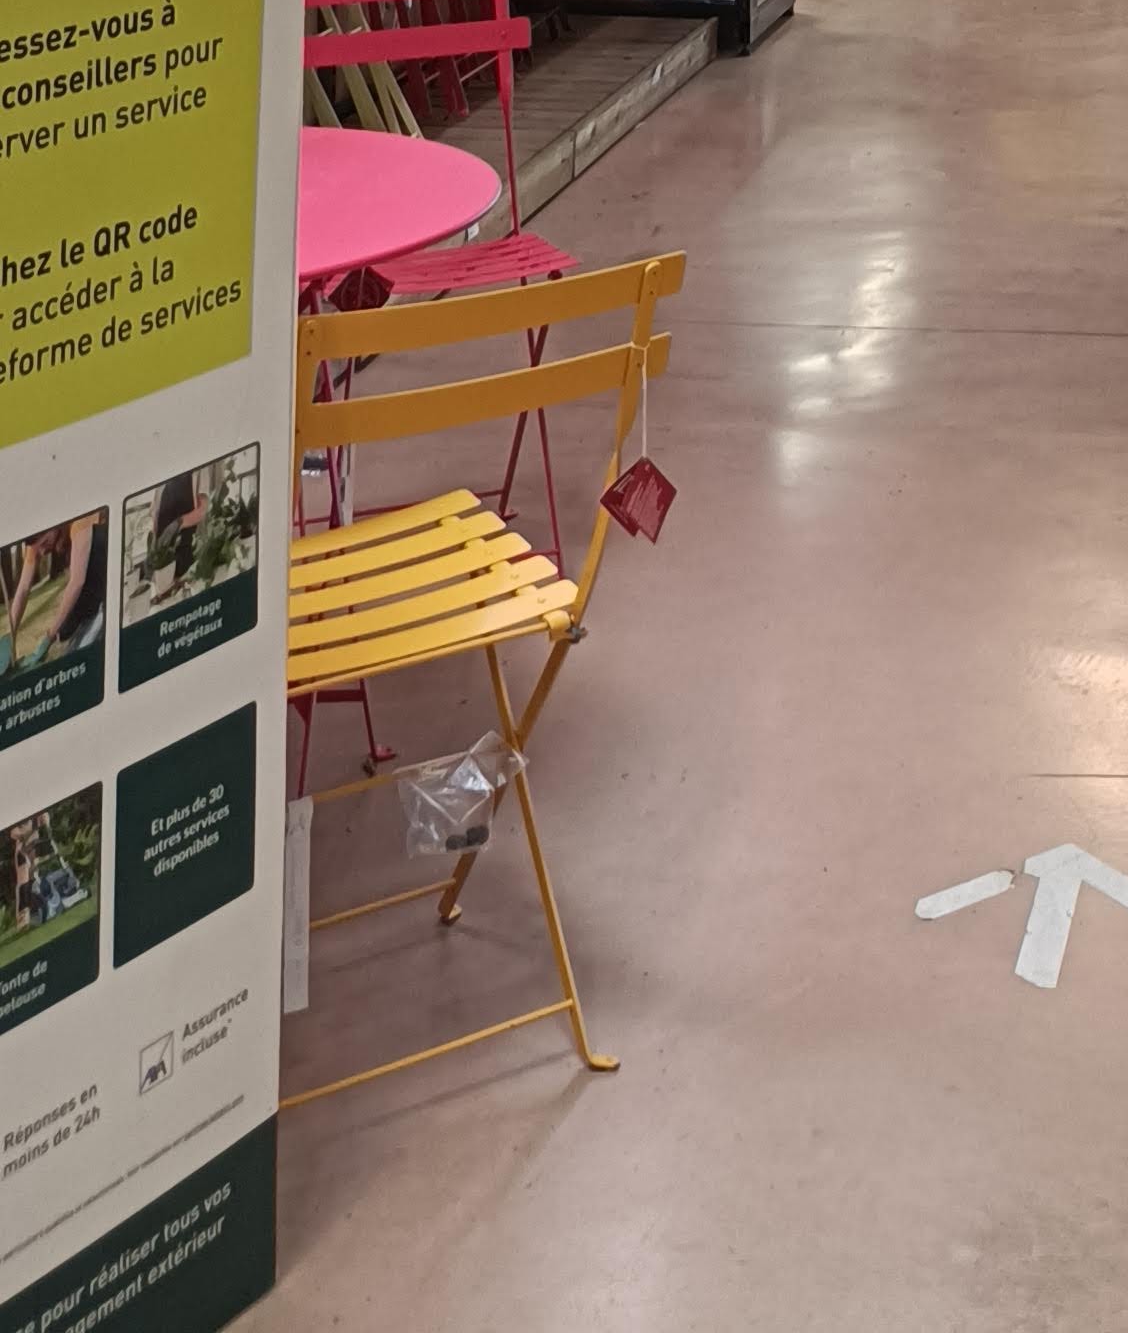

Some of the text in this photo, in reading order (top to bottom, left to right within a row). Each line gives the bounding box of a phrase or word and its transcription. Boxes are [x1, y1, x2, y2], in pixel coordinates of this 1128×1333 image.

[2, 36, 223, 110] conseillers pour
[0, 83, 207, 159] rver un service
[60, 237, 85, 269] le
[94, 221, 131, 257] QR
[139, 203, 198, 244] code
[12, 254, 175, 331] accéder à la
[102, 310, 133, 351] de
[141, 277, 242, 335] services
[157, 617, 224, 659] de végétaux
[160, 598, 222, 637] Rempotage
[5, 695, 61, 730] arbustes
[144, 804, 230, 862] autres services
[151, 783, 224, 836] Et plus de 30
[153, 831, 220, 877] disponibles
[32, 960, 48, 978] de
[182, 988, 248, 1042] Assurance
[3, 1084, 98, 1152] Réponses en
[3, 1105, 100, 1178] moins de 24h
[41, 1285, 85, 1333] pour
[89, 1232, 160, 1297] réaliser
[164, 1204, 200, 1243] tous
[204, 1182, 232, 1214] vos
[148, 1215, 225, 1286] extérieur
